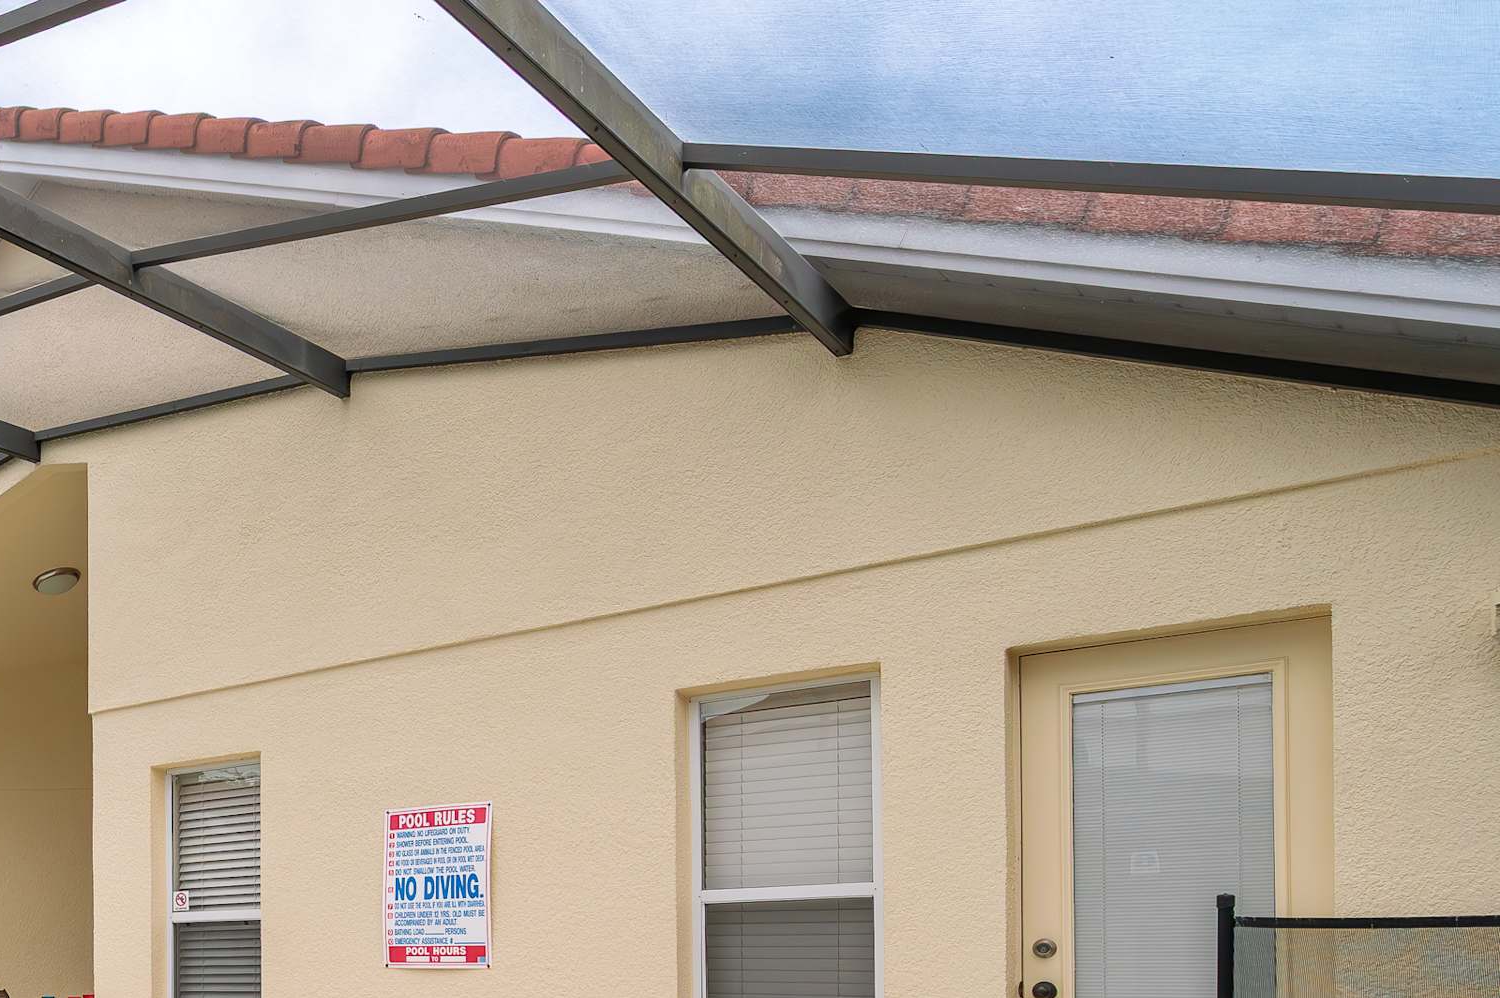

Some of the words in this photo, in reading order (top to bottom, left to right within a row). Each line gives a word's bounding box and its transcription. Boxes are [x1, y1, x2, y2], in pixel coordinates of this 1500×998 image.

[398, 814, 430, 829] POOL
[434, 809, 476, 826] RULES
[457, 826, 470, 834] DUTY
[415, 839, 431, 847] BEFORE
[433, 837, 454, 846] ENTERING
[395, 876, 417, 901] NO
[424, 873, 484, 899] DIVING.
[395, 911, 416, 919] CHILDREN
[445, 927, 466, 935] PERSONS
[406, 946, 430, 956] POOL
[433, 946, 467, 956] HOURS
